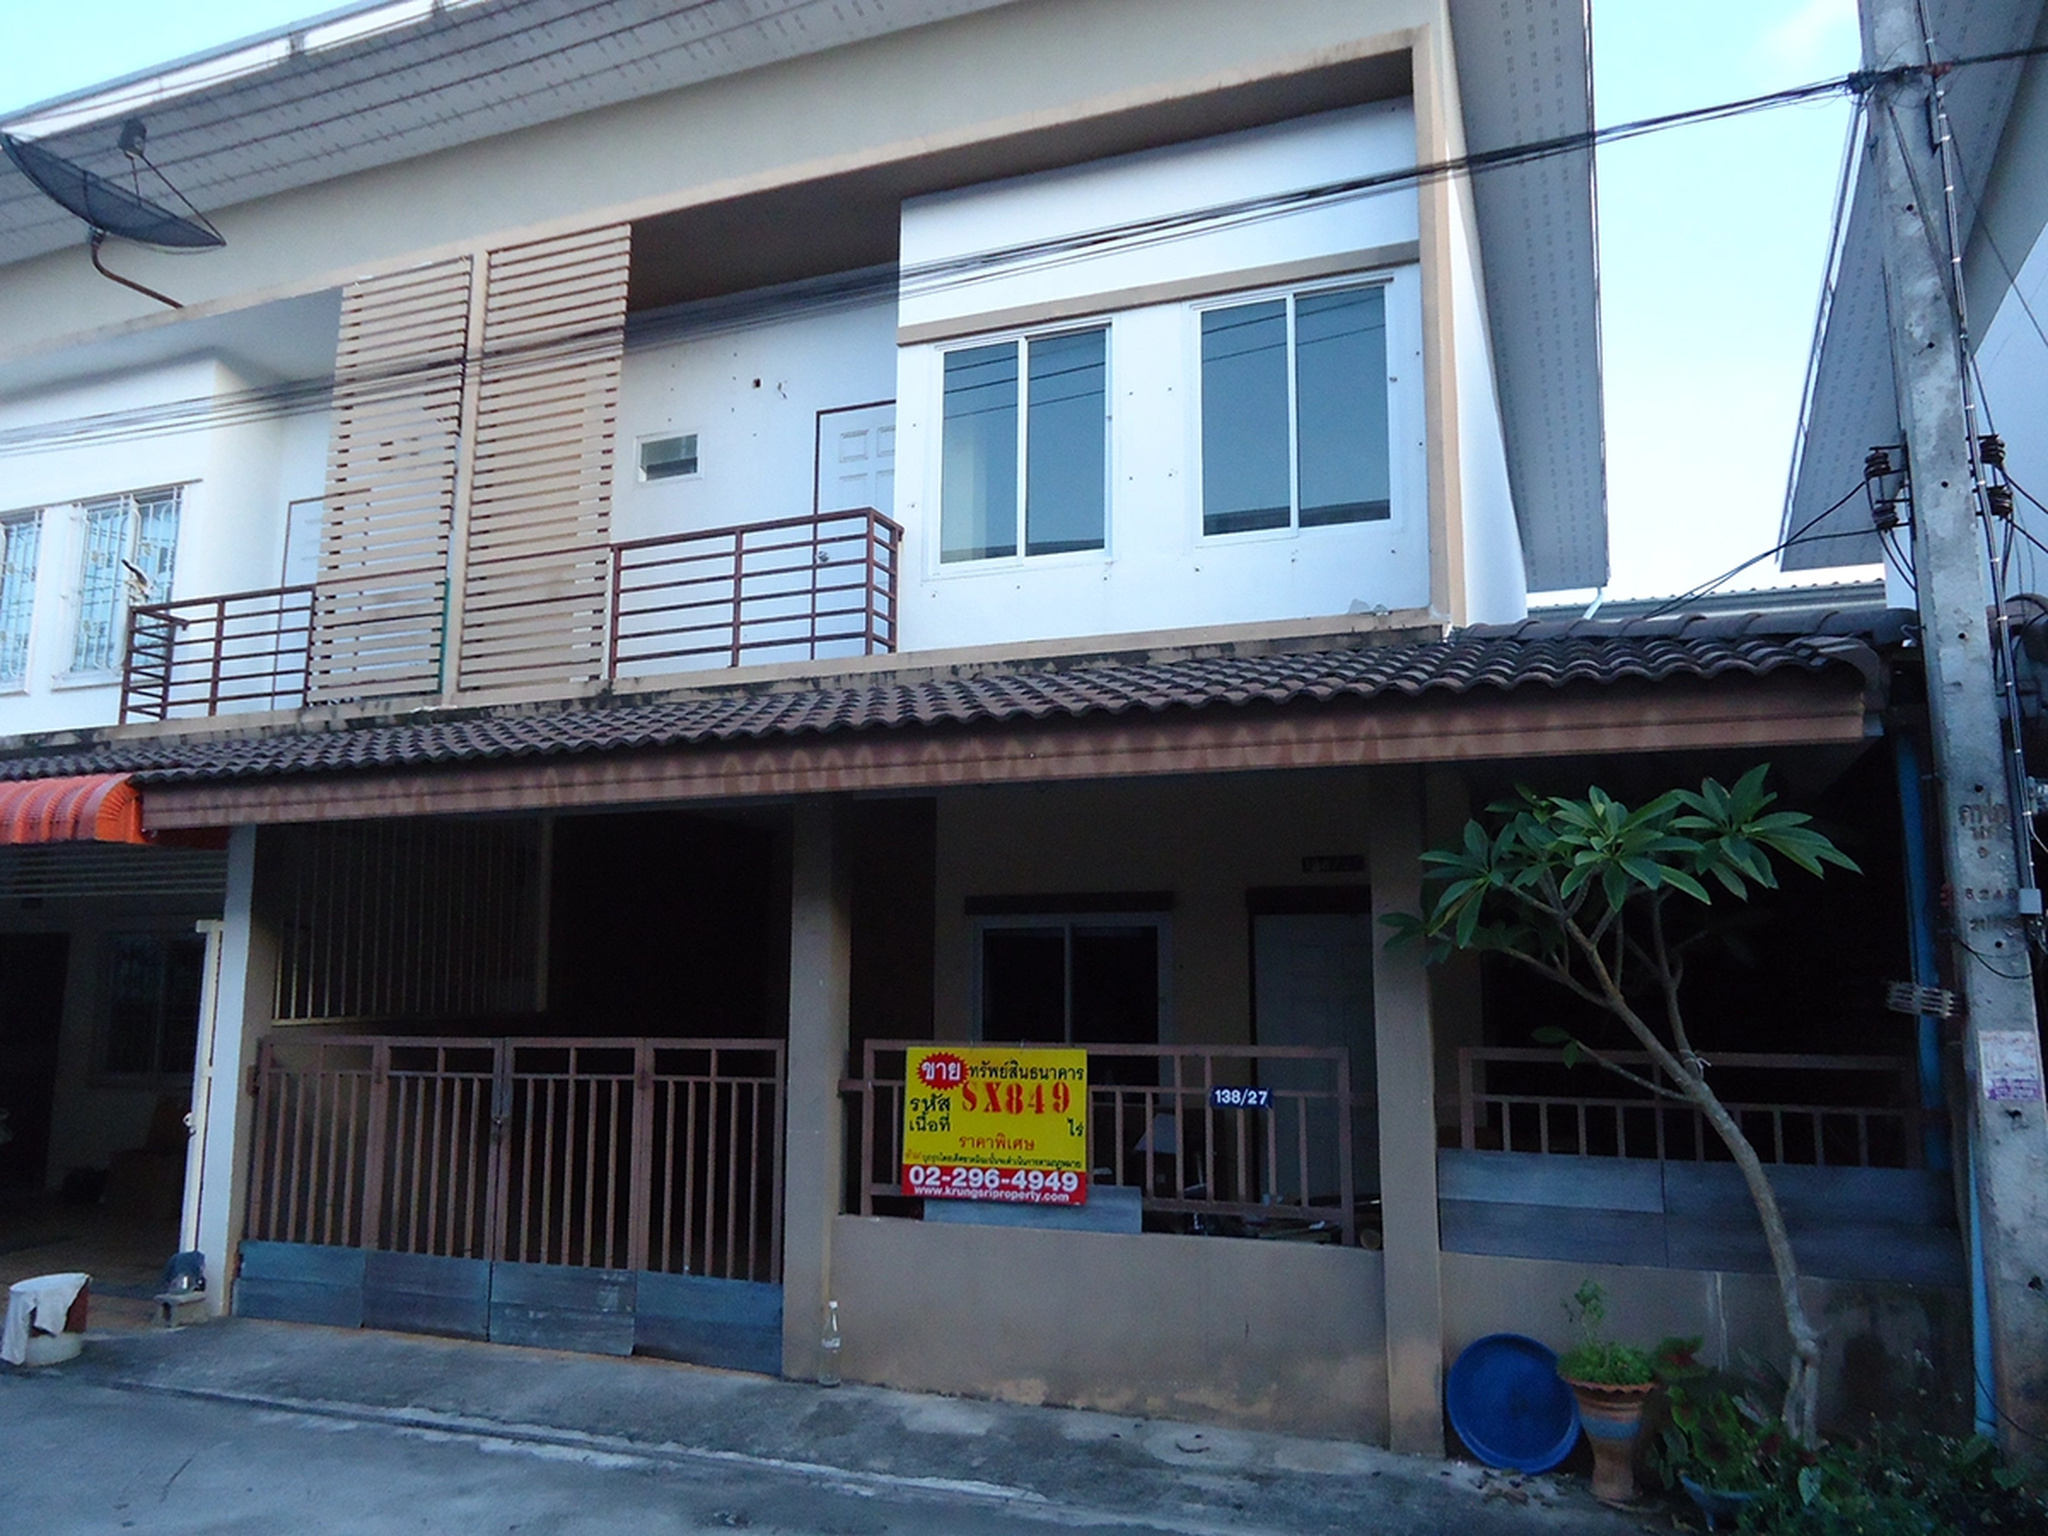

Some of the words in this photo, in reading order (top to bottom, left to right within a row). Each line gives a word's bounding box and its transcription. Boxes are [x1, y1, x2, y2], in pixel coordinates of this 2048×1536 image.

[922, 1061, 961, 1081] ขาย
[969, 1060, 1084, 1081] ทรัพย์สินธนาคาร
[909, 1093, 951, 1112] รหัส
[961, 1081, 1071, 1115] SX849
[1215, 1088, 1268, 1106] 138/27
[909, 1111, 951, 1132] เนื้อที่
[1066, 1117, 1083, 1137] ไร่
[958, 1132, 1035, 1151] ราคาพิเศษ
[909, 1165, 1079, 1193] 02-296-4949
[914, 1185, 1070, 1202] www.krungsriproperty.com
